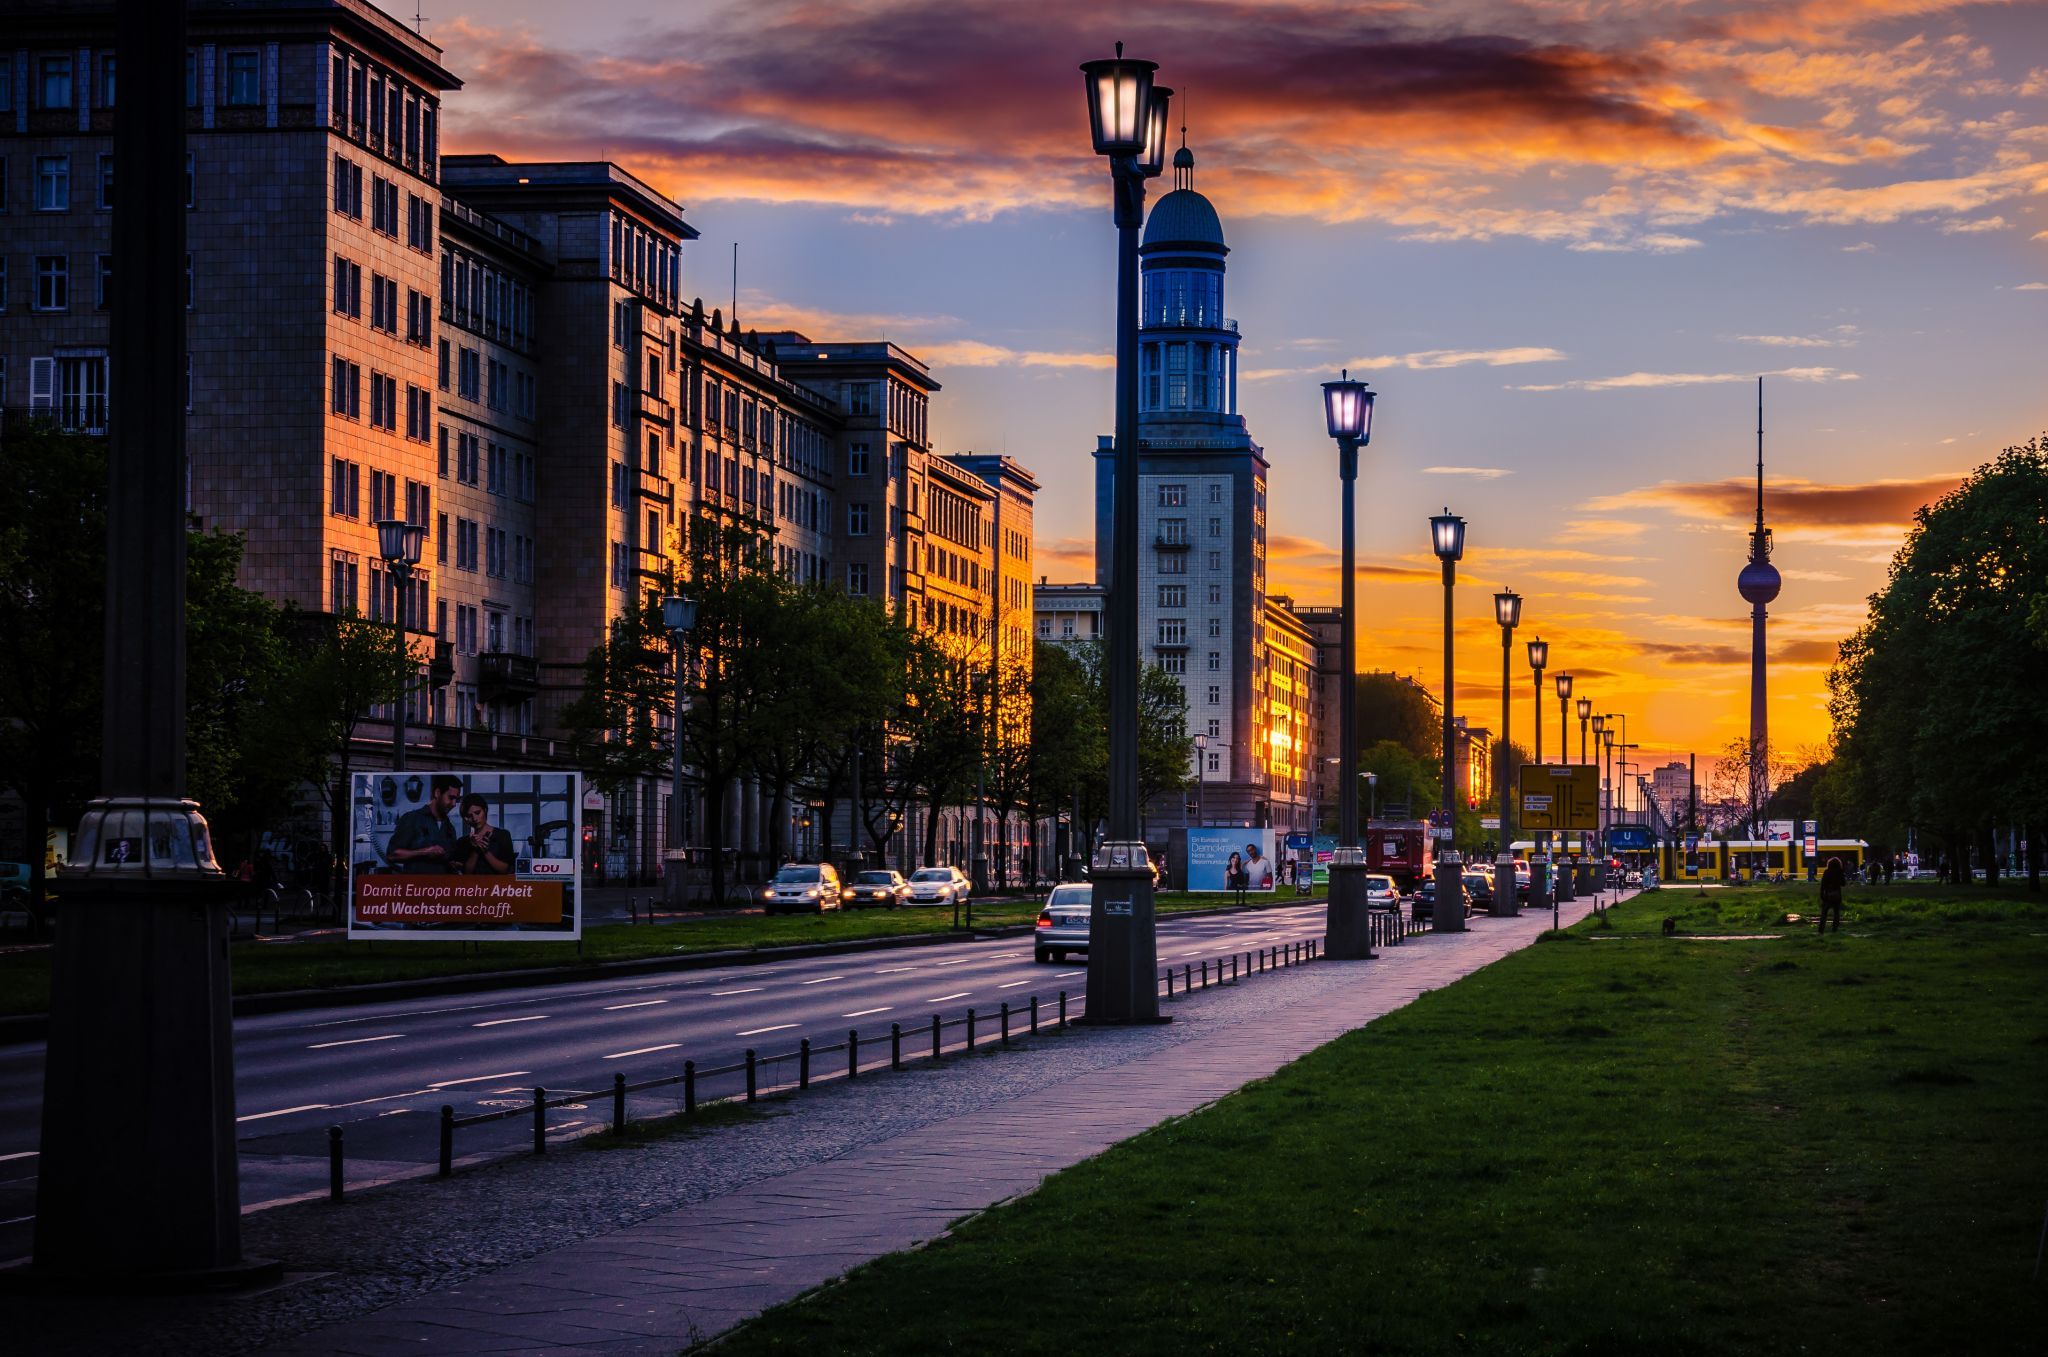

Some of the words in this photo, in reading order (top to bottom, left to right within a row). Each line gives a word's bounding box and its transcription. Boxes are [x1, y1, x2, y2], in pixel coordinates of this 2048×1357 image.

[1624, 832, 1631, 840] U
[532, 864, 560, 873] CDU
[363, 884, 402, 897] Damit
[405, 885, 450, 900] Europa
[454, 885, 489, 897] mehr
[490, 885, 533, 898] Arbeit
[362, 902, 387, 915] und
[391, 902, 463, 915] Wachstum
[465, 903, 515, 918] schafft.
